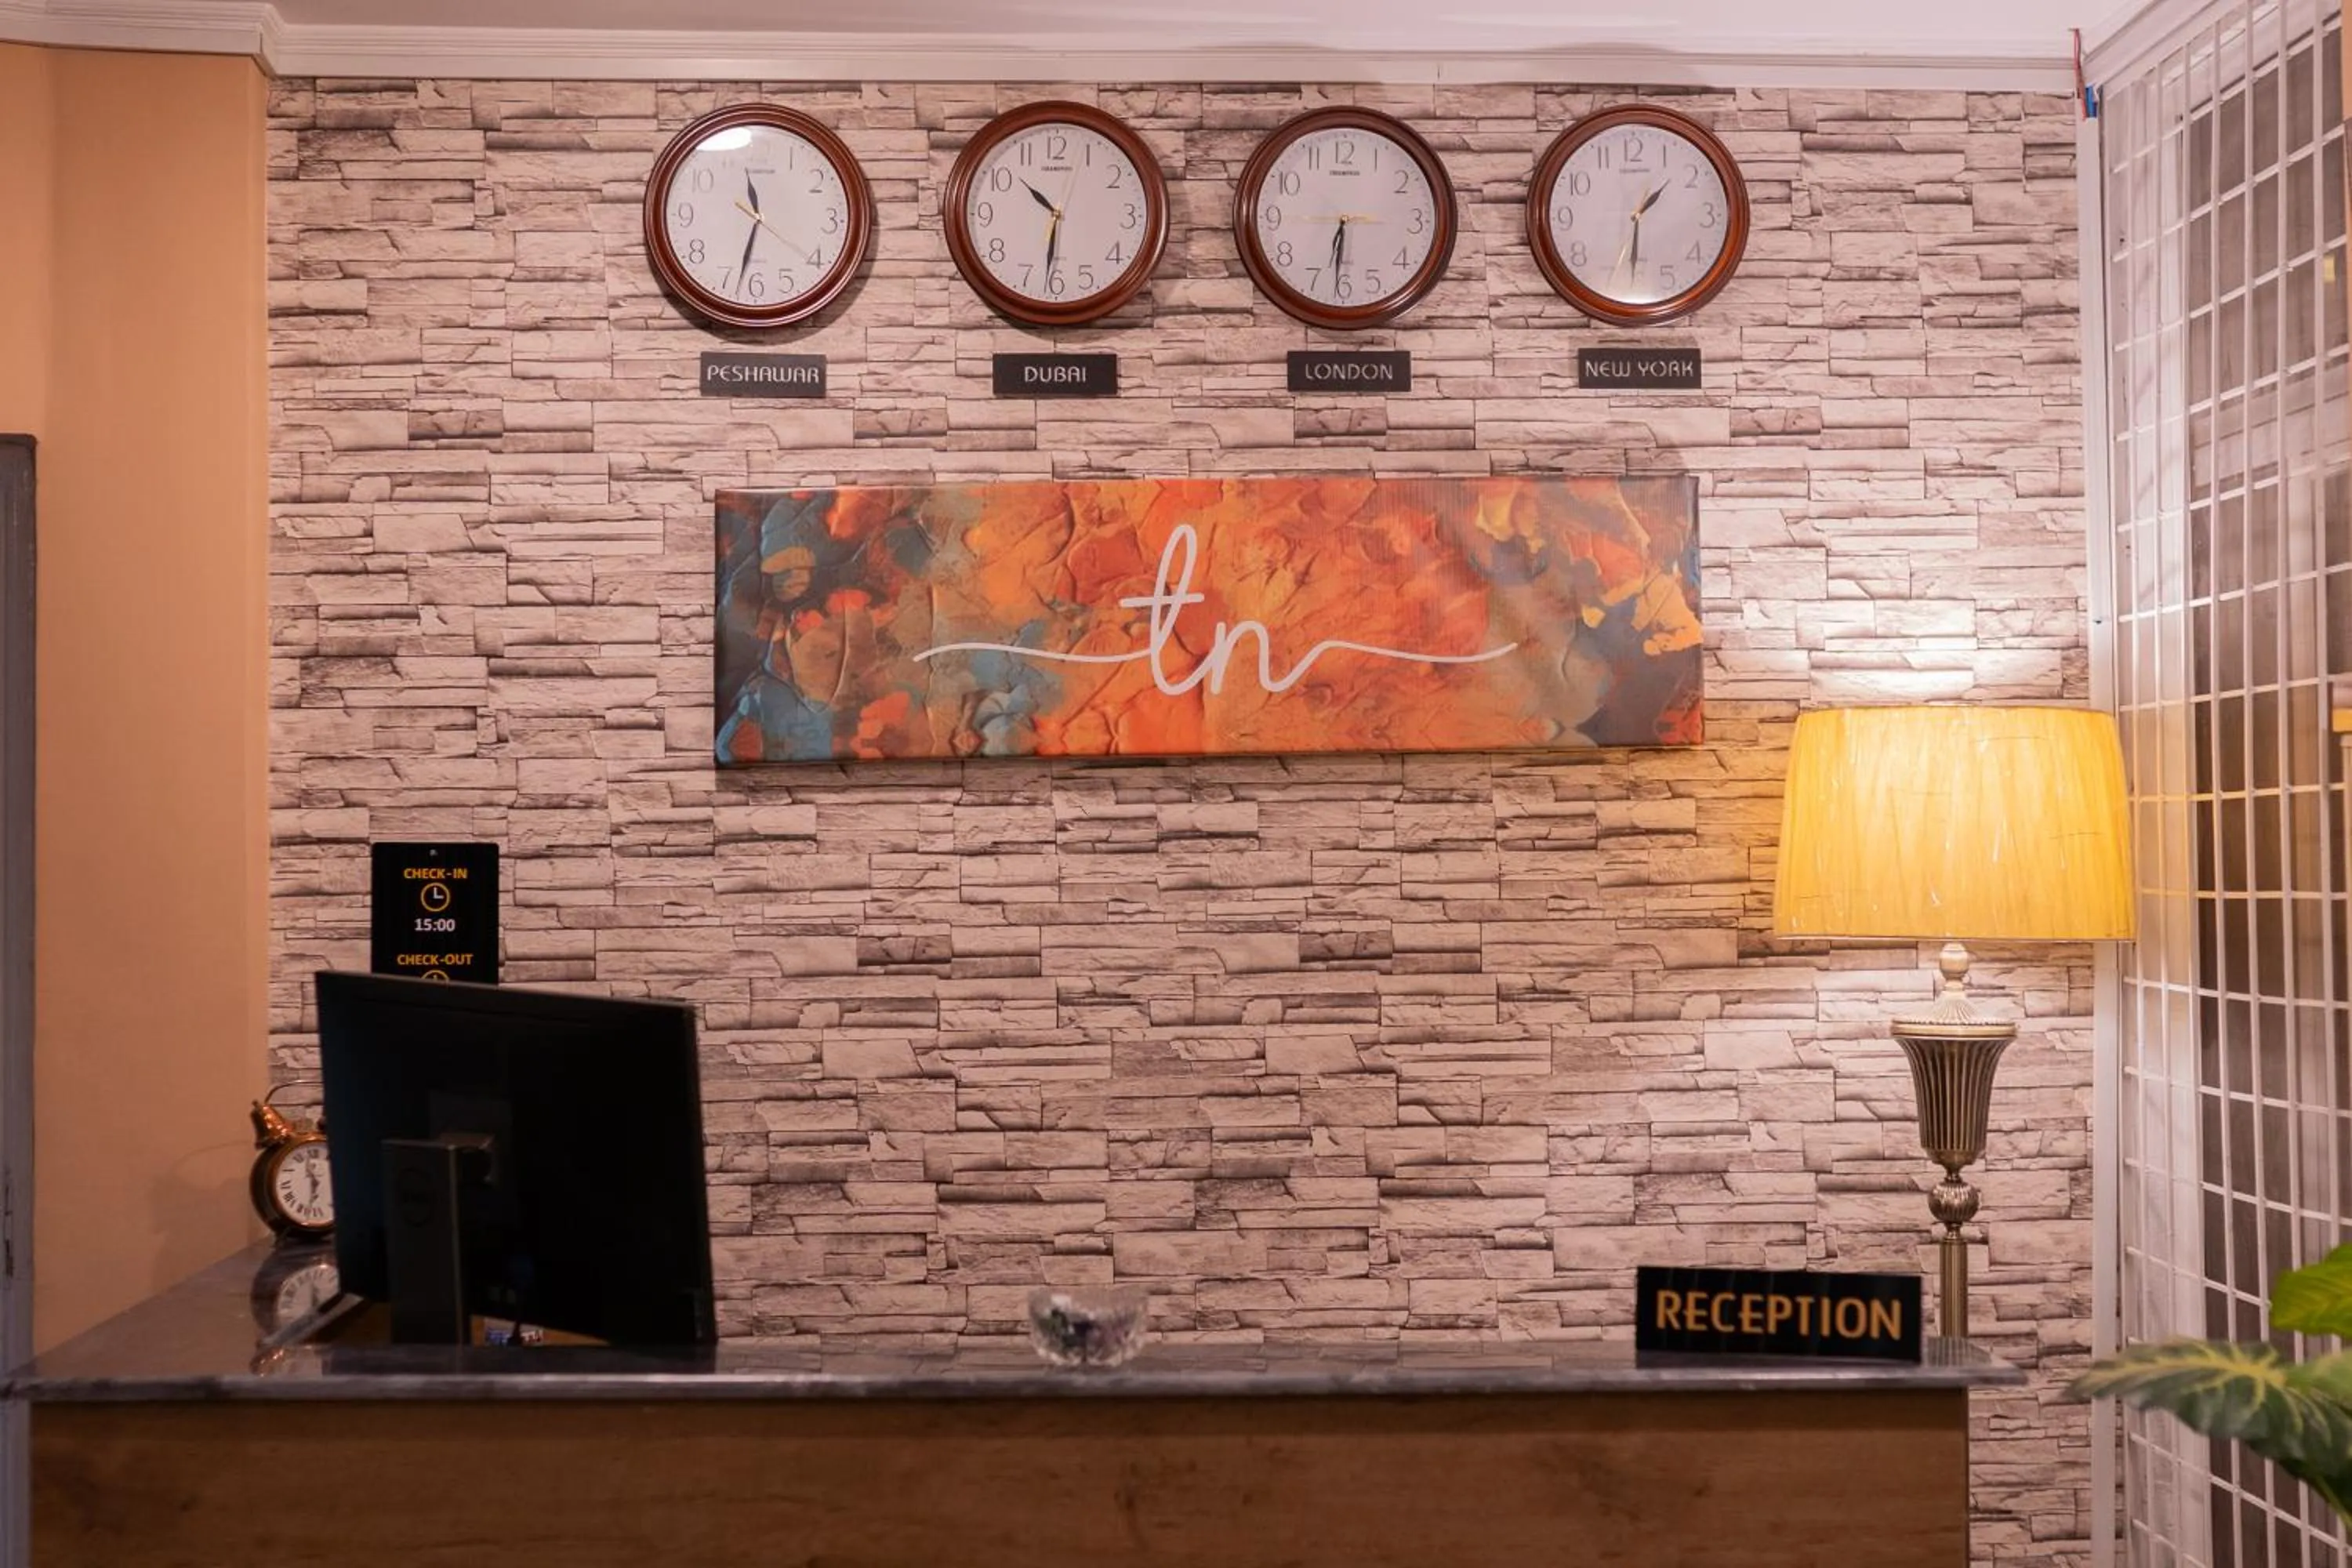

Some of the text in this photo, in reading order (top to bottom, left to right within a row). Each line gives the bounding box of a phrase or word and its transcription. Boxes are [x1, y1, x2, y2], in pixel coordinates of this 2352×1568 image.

[1020, 142, 1032, 166] 11
[1047, 136, 1067, 160] 12
[1308, 147, 1320, 170] 11
[1335, 140, 1355, 165] 12
[1597, 146, 1610, 169] 11
[1624, 137, 1643, 162] 12
[691, 169, 713, 193] 10
[808, 169, 824, 193] 2
[991, 166, 1012, 192] 10
[1106, 165, 1121, 188] 2
[1279, 171, 1301, 196] 10
[1394, 170, 1409, 193] 2
[1570, 171, 1591, 196] 10
[1684, 165, 1698, 188] 2
[678, 201, 694, 227] 9
[822, 208, 838, 234] 3
[978, 201, 993, 227] 9
[1120, 203, 1136, 229] 3
[1265, 205, 1281, 231] 9
[1406, 209, 1423, 234] 3
[1558, 206, 1573, 231] 9
[1700, 202, 1715, 228] 3
[689, 238, 705, 264] 8
[805, 245, 824, 269] 4
[989, 238, 1004, 263] 8
[1105, 241, 1123, 264] 4
[1277, 241, 1292, 267] 8
[1392, 245, 1410, 270] 4
[1570, 241, 1587, 267] 8
[1685, 241, 1701, 264] 4
[717, 267, 733, 289] 7
[749, 272, 764, 298] 6
[779, 269, 794, 294] 5
[1018, 264, 1033, 287] 7
[1049, 270, 1065, 295] 6
[1078, 265, 1094, 289] 5
[1305, 267, 1322, 292] 7
[1336, 274, 1352, 299] 6
[1366, 270, 1381, 295] 5
[1660, 265, 1675, 290] 5
[707, 365, 819, 383] PESHAWAR
[1024, 366, 1087, 383] DUBAI
[1305, 363, 1393, 380] LONDON
[1585, 360, 1693, 377] NEW YORK
[404, 868, 468, 879] CHECK-IN
[414, 918, 456, 931] 15:00
[397, 954, 474, 965] CHECK-OUT
[1656, 1290, 1902, 1341] RECEPTION
